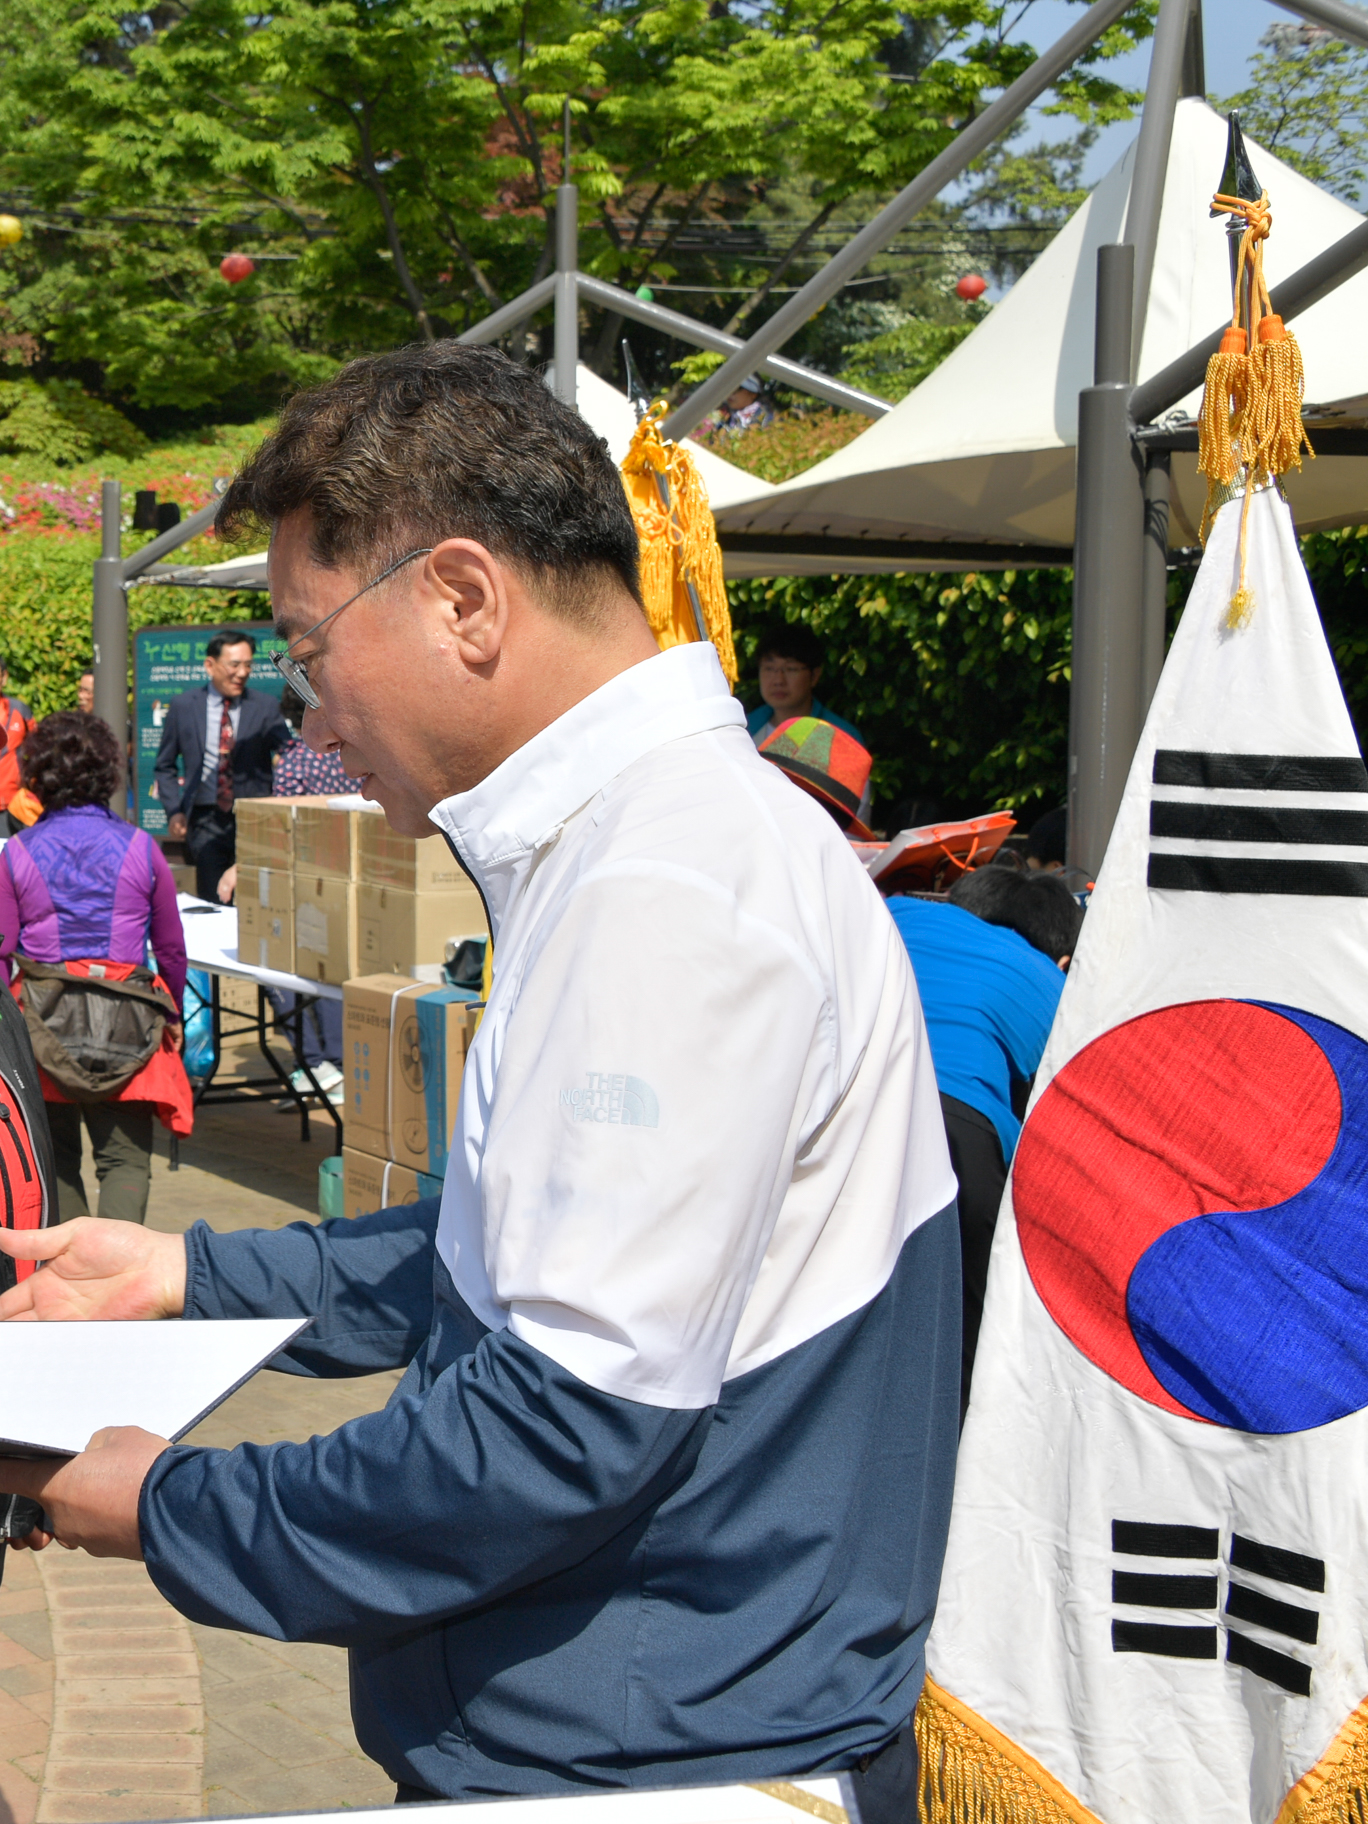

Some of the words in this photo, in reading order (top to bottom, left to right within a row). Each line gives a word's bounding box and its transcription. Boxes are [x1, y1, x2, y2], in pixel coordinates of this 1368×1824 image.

[586, 1071, 624, 1091] THE
[559, 1088, 623, 1108] NORTH
[573, 1105, 621, 1124] FACE
